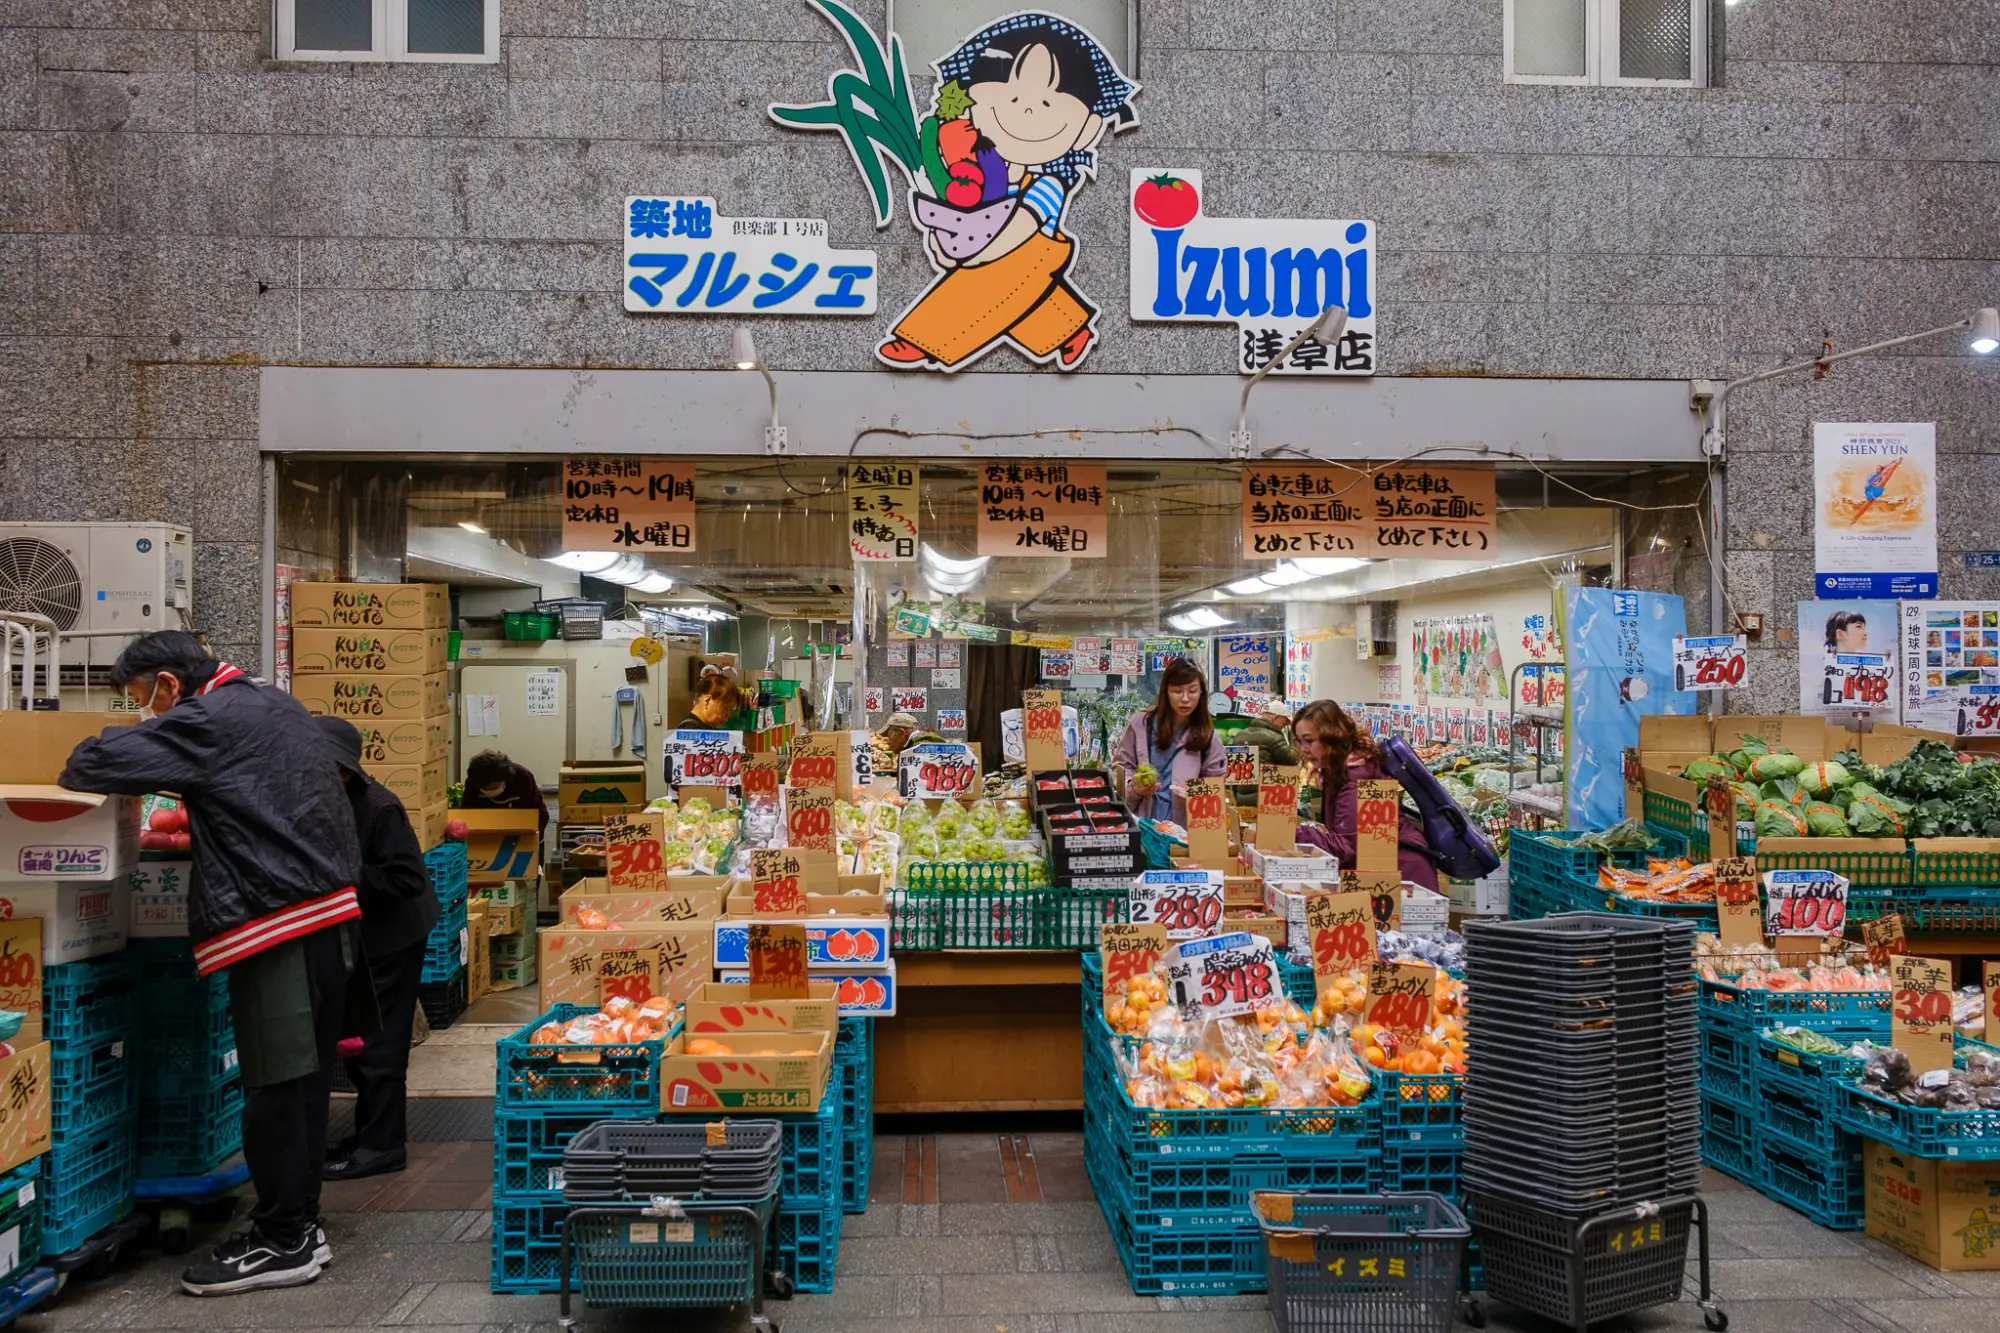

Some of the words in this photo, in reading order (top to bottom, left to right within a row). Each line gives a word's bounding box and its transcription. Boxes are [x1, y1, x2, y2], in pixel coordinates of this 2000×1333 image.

[629, 198, 713, 239] 築地
[628, 251, 874, 309] マルシェ
[1151, 222, 1372, 318] Izumi
[1243, 329, 1373, 371] 浅草店
[1842, 445, 1877, 454] SHEN
[1881, 445, 1908, 454] YUN
[566, 459, 642, 478] 営業時間
[852, 465, 913, 486] 金曜日
[985, 466, 1068, 484] 営業時間
[1249, 473, 1334, 496] 自転車は
[565, 504, 619, 524] 定休日
[987, 507, 1044, 522] 定休日
[1251, 498, 1363, 523] 当店の正面に
[1375, 496, 1485, 517] 当店の正面に
[612, 521, 691, 548] 水曜日
[1016, 526, 1088, 552] 水曜日
[1254, 531, 1354, 552] とめて下さい
[1377, 526, 1488, 550] とめて下さい
[333, 590, 383, 608] KUMA
[333, 608, 384, 625] MOTO
[335, 635, 386, 654] KUMA
[335, 653, 386, 670] MOTO
[1696, 656, 1745, 684] 250
[1907, 624, 1921, 710] 地球一周の船旅
[334, 680, 384, 698] KUMA
[1844, 675, 1888, 702] 198
[334, 699, 384, 715] MOTO
[1027, 709, 1061, 731] 880
[684, 754, 740, 778] 1800
[919, 763, 975, 792] 980
[1260, 785, 1296, 806] 780
[1188, 796, 1222, 819] 980
[1357, 800, 1396, 826] 680
[791, 809, 831, 837] 980
[56, 849, 104, 863] りんご
[753, 857, 800, 878] 富士柿
[481, 887, 510, 900] ねぎ
[1130, 888, 1157, 902] 山形
[1791, 884, 1845, 900] にんじん
[1154, 896, 1222, 930] 280
[1781, 896, 1845, 931] 100
[1103, 925, 1139, 935] 和歌山
[1104, 935, 1165, 952] 有田みかん
[1314, 921, 1369, 964] 598
[569, 954, 593, 976] 新
[1896, 967, 1948, 984] 里芋
[1201, 963, 1274, 1006] 398
[1371, 976, 1432, 998] 恵みかん
[1367, 993, 1430, 1028] 480
[1895, 990, 1951, 1021] 30
[10, 1058, 37, 1110] 梨
[742, 1091, 811, 1107] たねなし柿
[1885, 1175, 1923, 1206] 玉ねぎ
[1611, 1223, 1661, 1252] イズミ
[1328, 1257, 1406, 1277] イズミ
